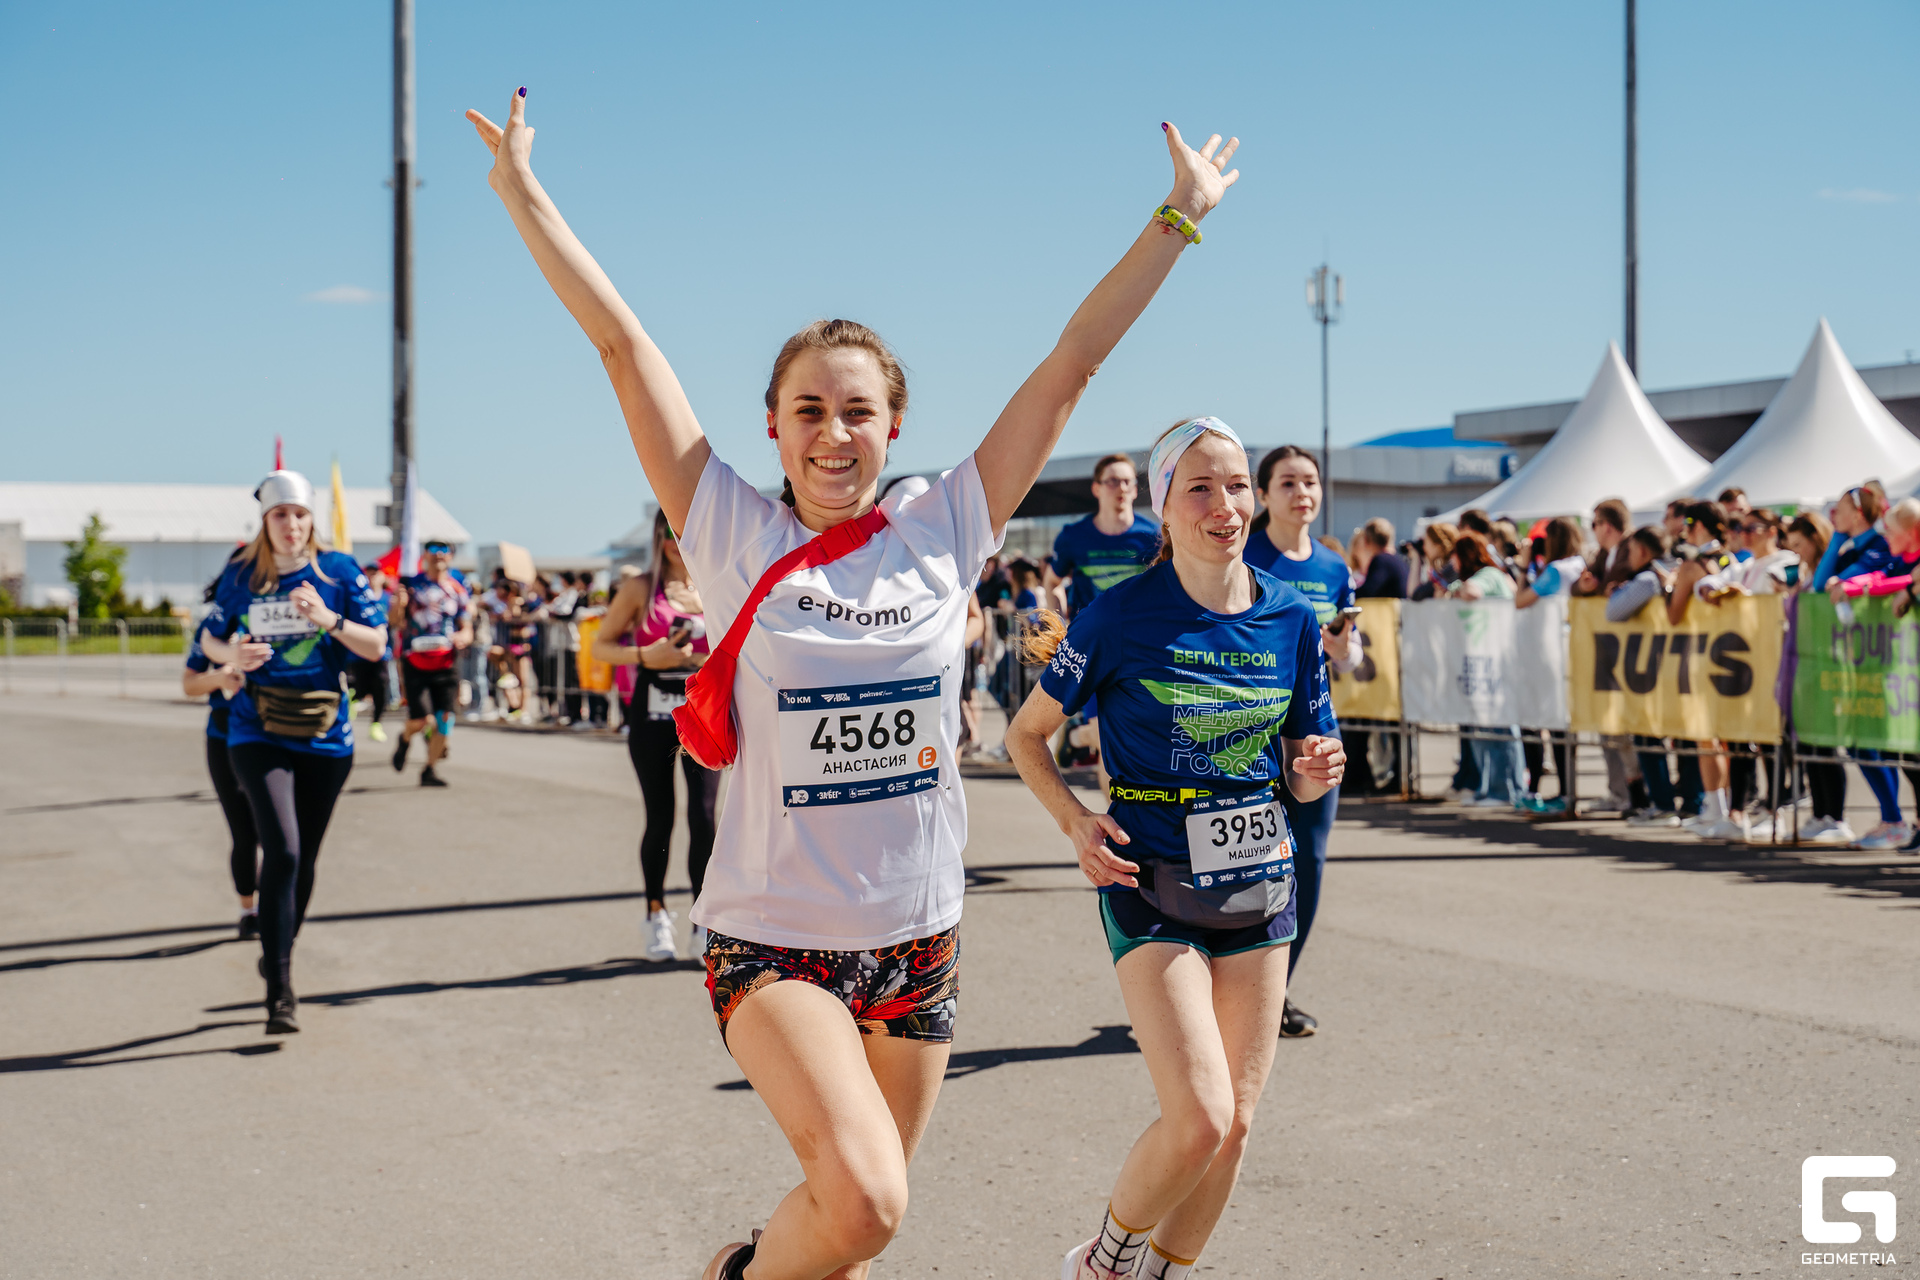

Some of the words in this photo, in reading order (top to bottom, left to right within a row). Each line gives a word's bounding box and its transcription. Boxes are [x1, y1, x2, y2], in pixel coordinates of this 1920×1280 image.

[797, 595, 912, 626] e-promo
[1173, 649, 1219, 667] БЕГИ,
[1220, 650, 1277, 667] ГЕРОЙ!
[1593, 632, 1754, 697] RUTS
[786, 696, 796, 705] 10
[809, 708, 916, 755] 4568
[1172, 705, 1280, 729] МЕНЯЮТ
[1170, 724, 1273, 757] ЭТОТ
[822, 753, 907, 775] АНАСТАСИЯ
[1170, 748, 1269, 780] ГОРОД
[1209, 808, 1278, 848] 3953
[1228, 844, 1271, 861] МАШУНЯ
